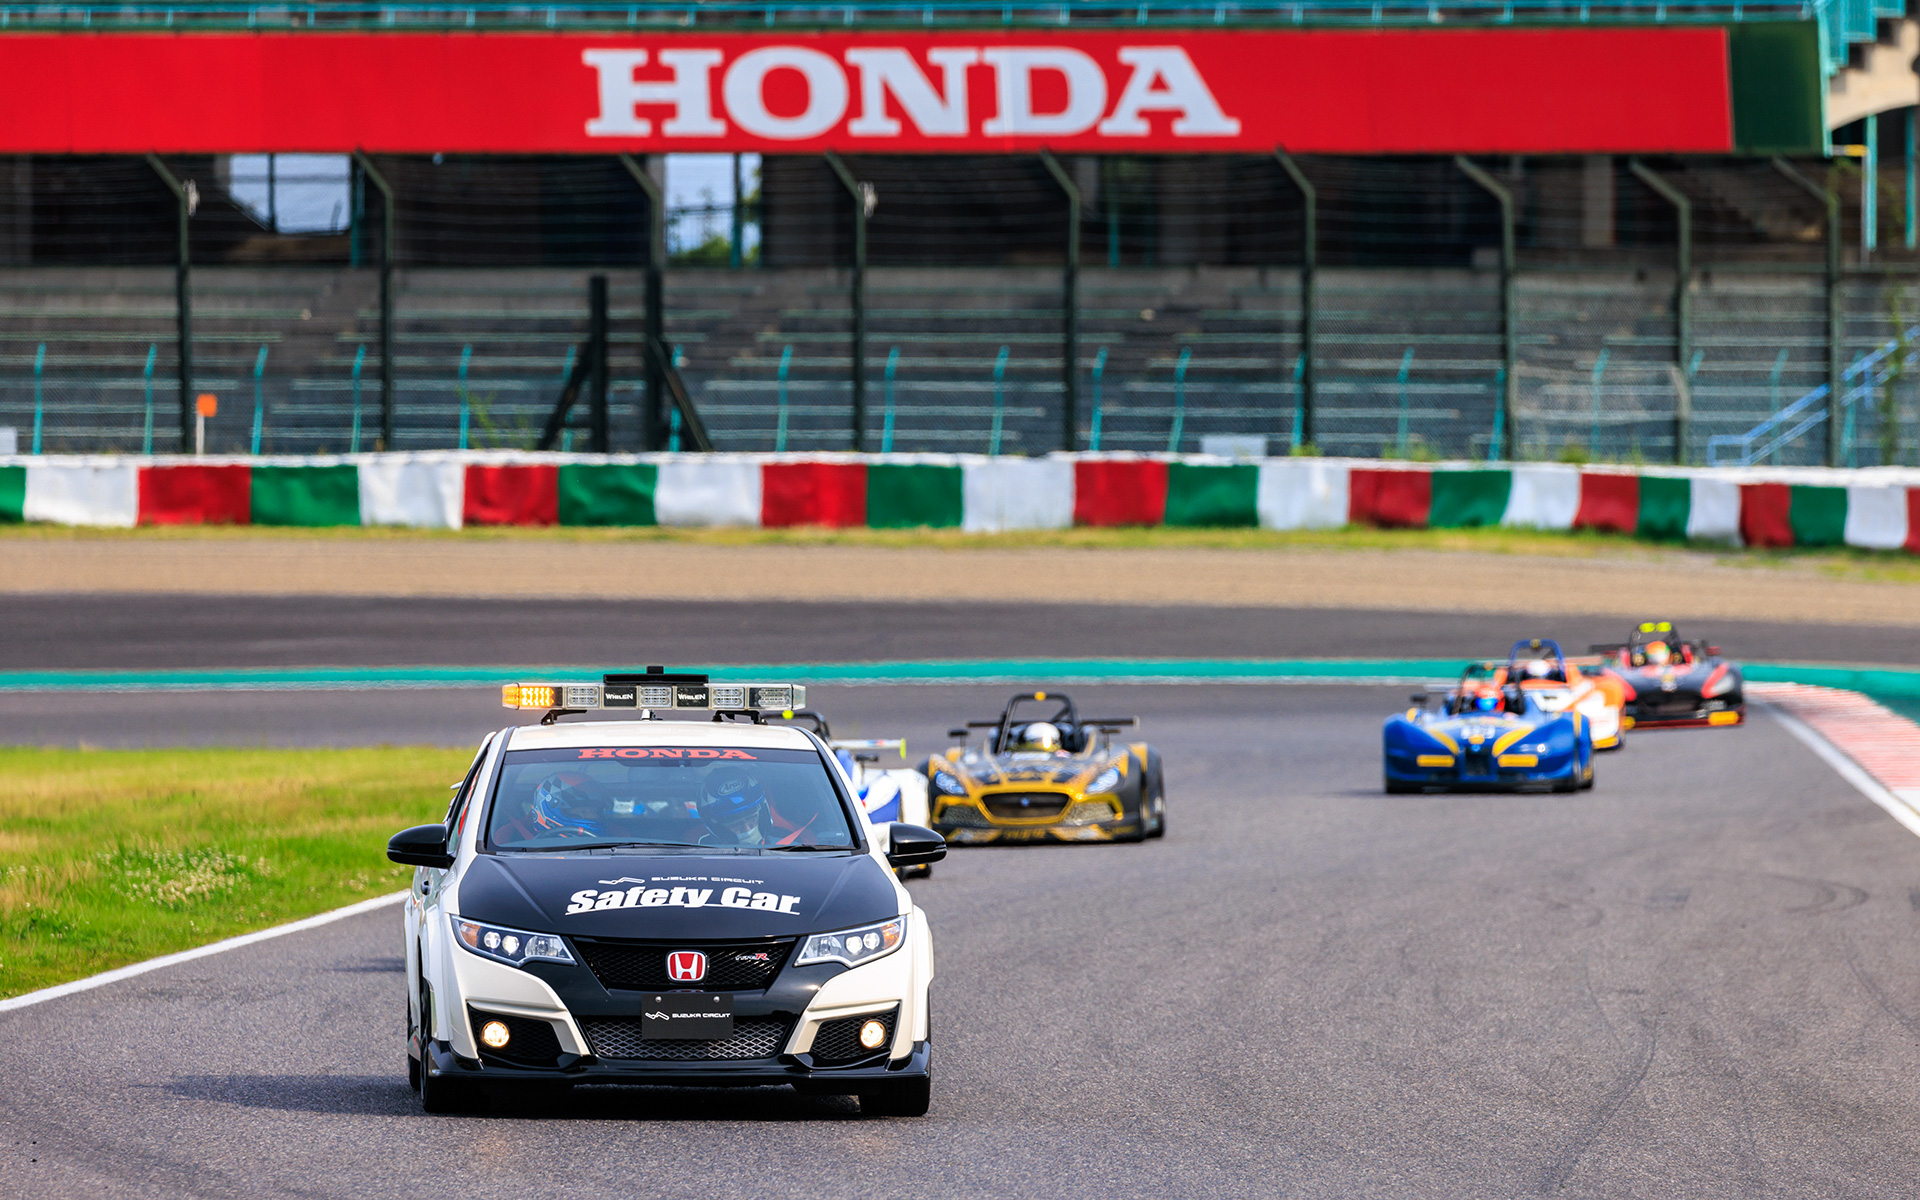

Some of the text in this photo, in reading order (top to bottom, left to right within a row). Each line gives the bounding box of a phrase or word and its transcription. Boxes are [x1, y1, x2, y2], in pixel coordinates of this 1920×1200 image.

[582, 46, 1241, 140] HONDA
[578, 748, 757, 760] HONDA
[711, 876, 764, 885] CIRCUIT
[566, 886, 801, 914] Safety Car
